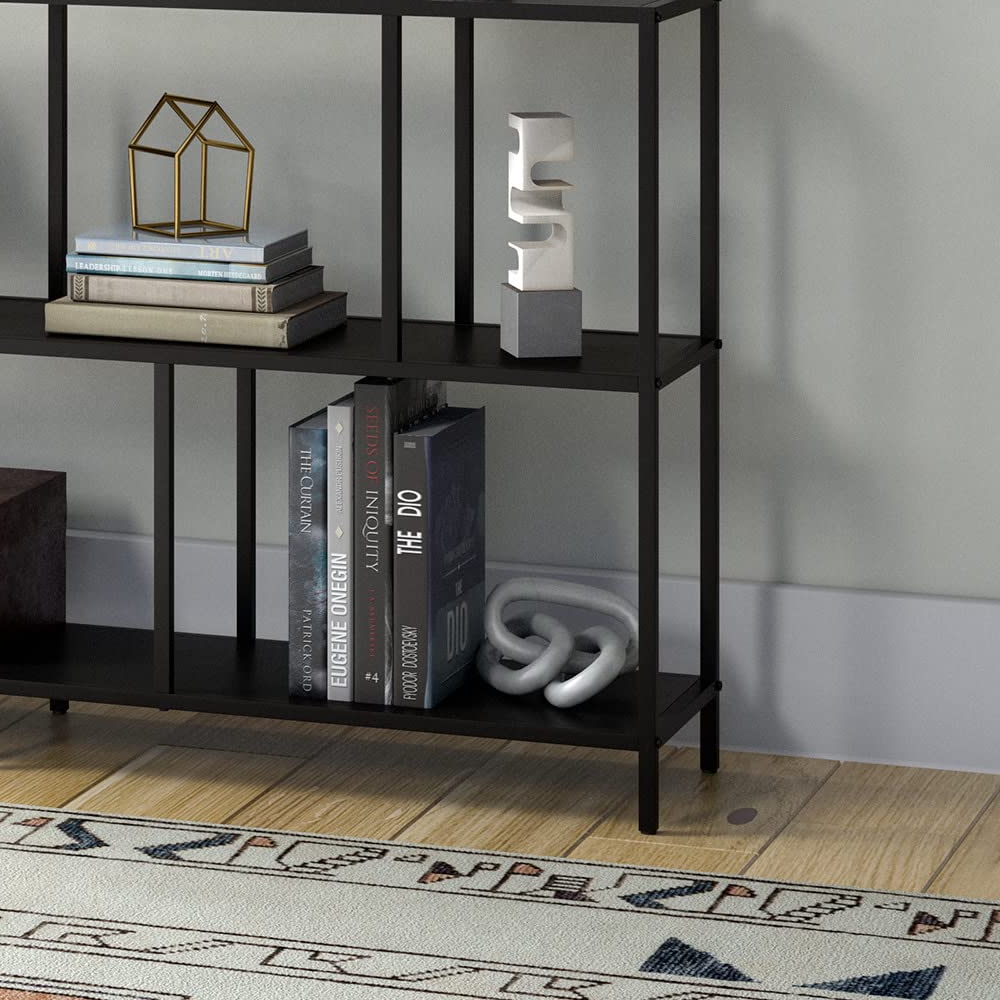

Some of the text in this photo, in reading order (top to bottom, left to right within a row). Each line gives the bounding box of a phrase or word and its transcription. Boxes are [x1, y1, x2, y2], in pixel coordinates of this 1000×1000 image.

[75, 262, 121, 272] LEADERSHIP
[300, 448, 314, 533] THE CURTAIN
[362, 405, 379, 572] SEEDS OF INIQUITY
[396, 489, 422, 555] THE DIO
[302, 609, 312, 660] PATRICK
[331, 553, 347, 688] EUGENE ONEGIN
[447, 601, 468, 663] DIO
[365, 672, 379, 683] #4
[401, 625, 418, 700] FYODOR DOSTOEVSKY
